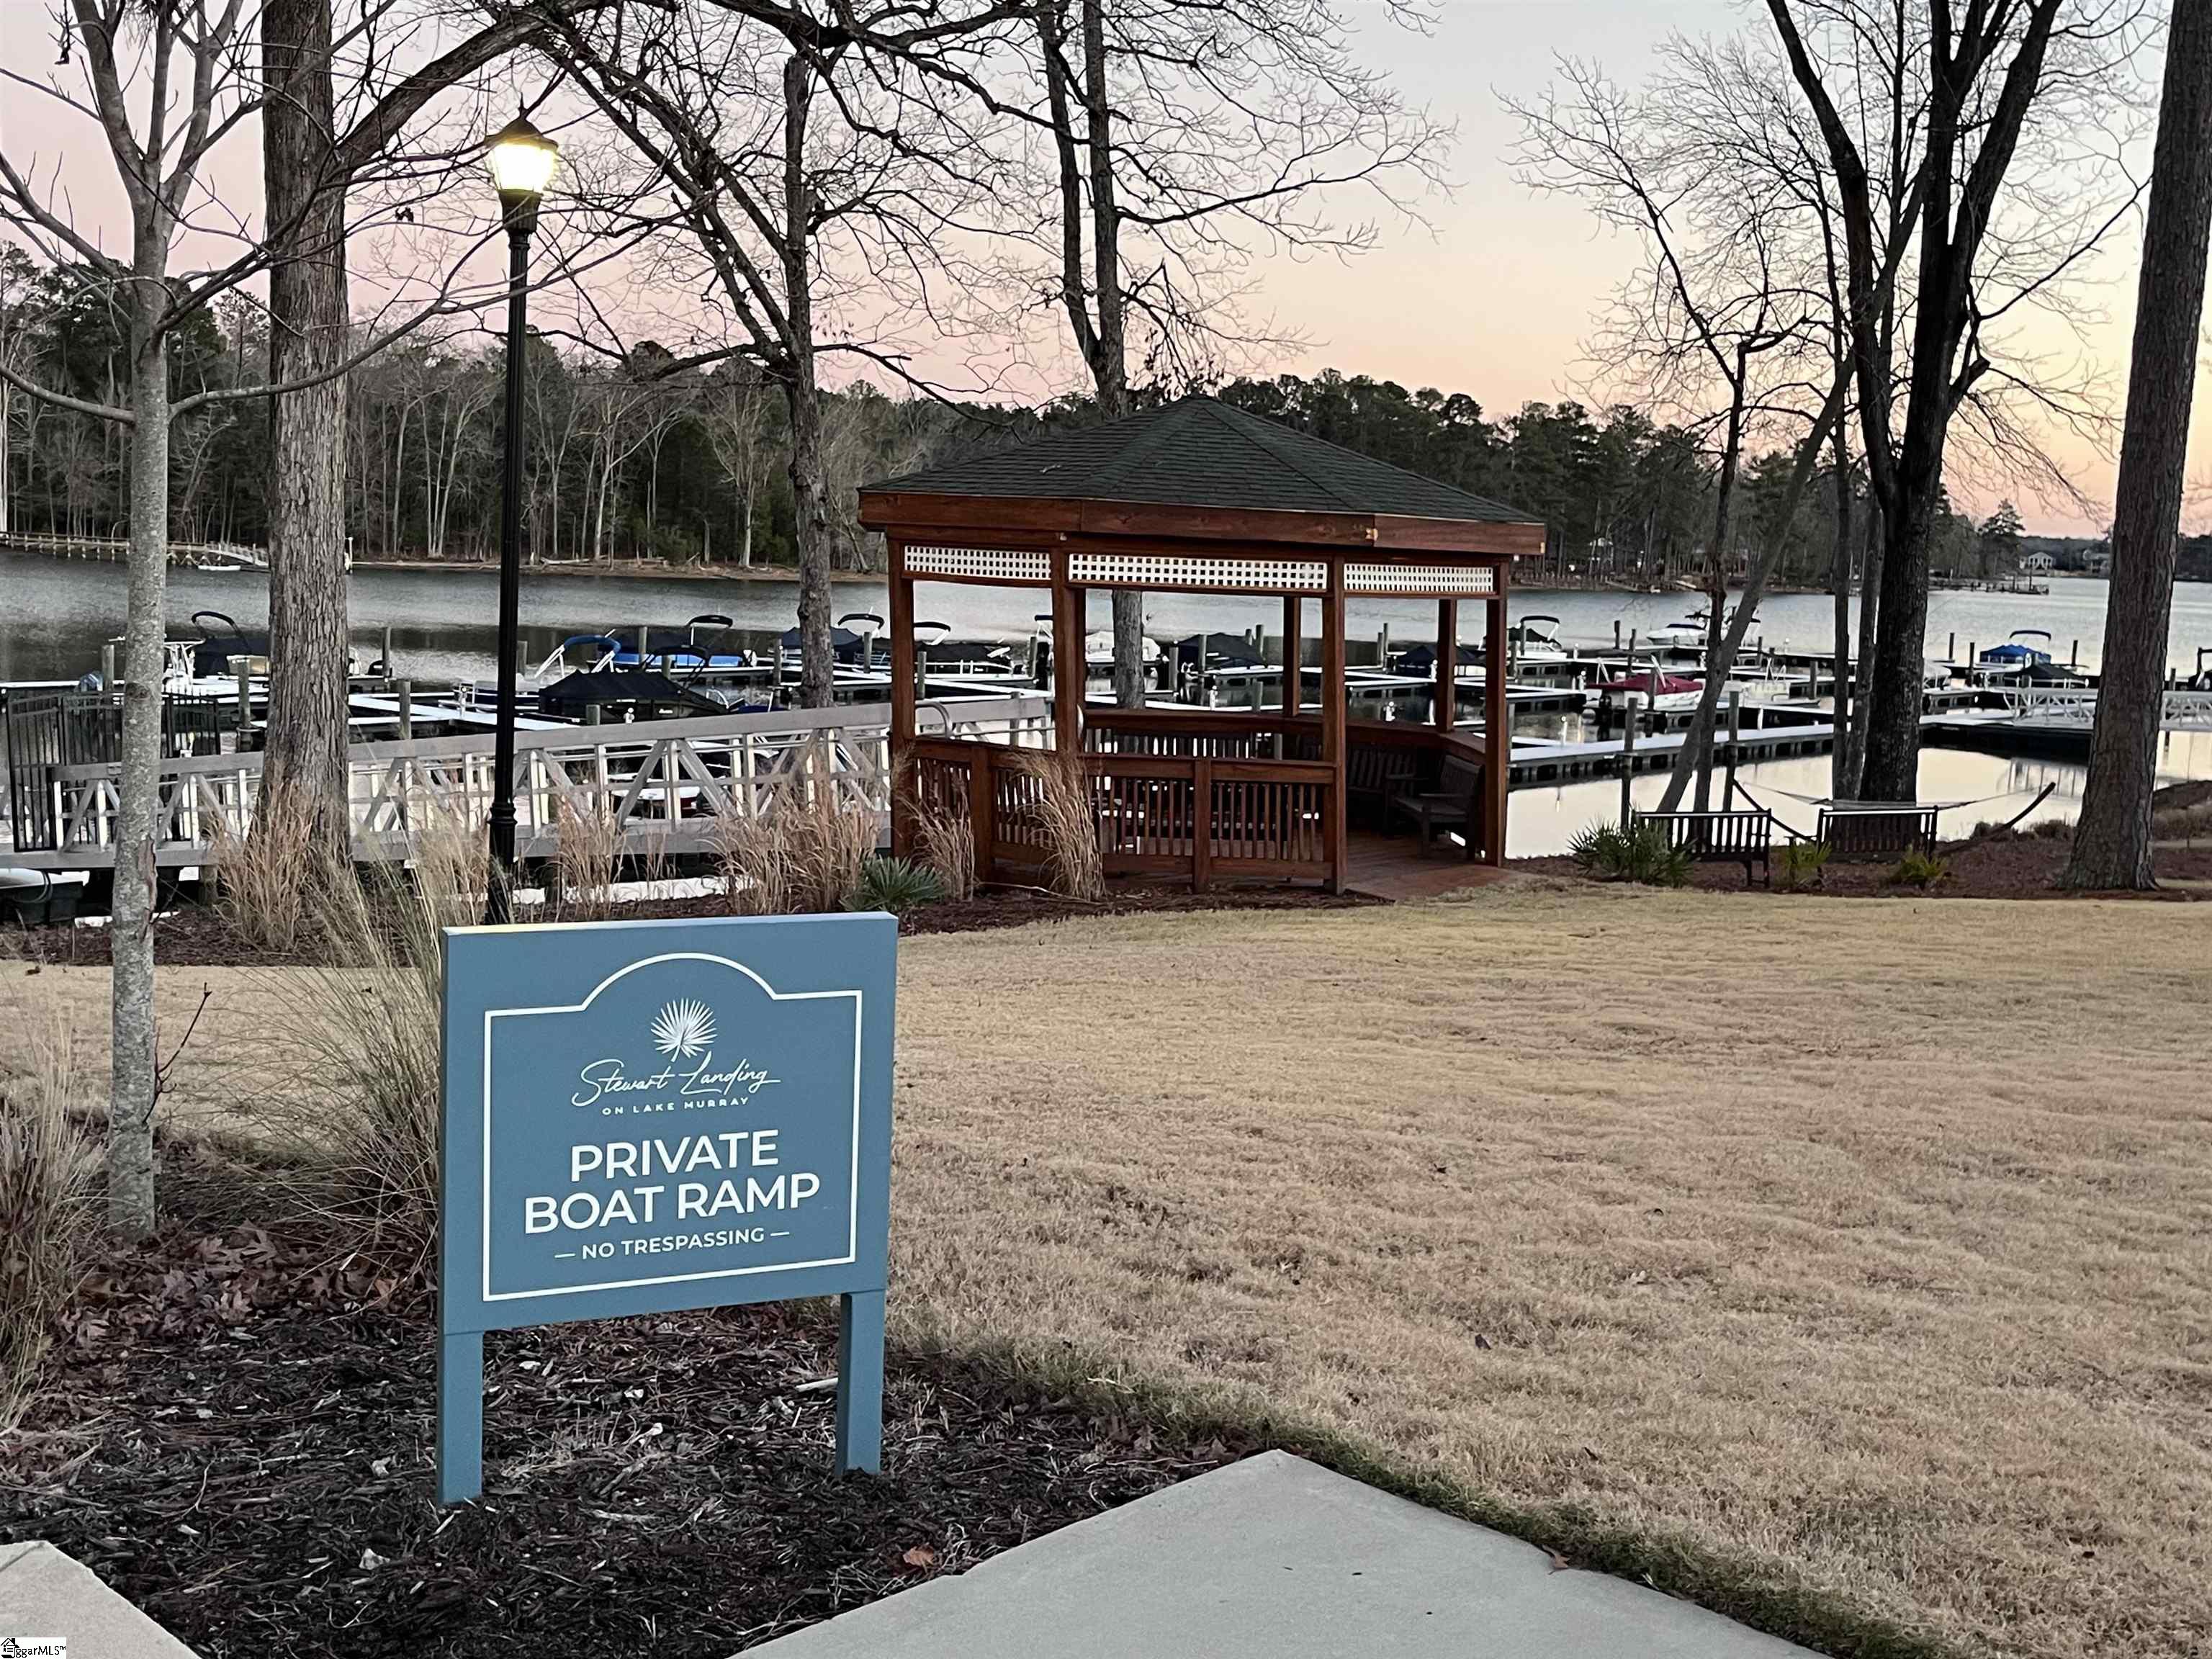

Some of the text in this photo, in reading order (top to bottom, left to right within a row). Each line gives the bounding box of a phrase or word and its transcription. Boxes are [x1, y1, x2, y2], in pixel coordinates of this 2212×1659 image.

[572, 1051, 781, 1107] Stewart Landing
[602, 1097, 748, 1115] ON LAKE MURRAY
[571, 1129, 778, 1182] PRIVATE
[525, 1172, 820, 1234] BOAT RAMP
[582, 1227, 765, 1259] NO TRESPASSING
